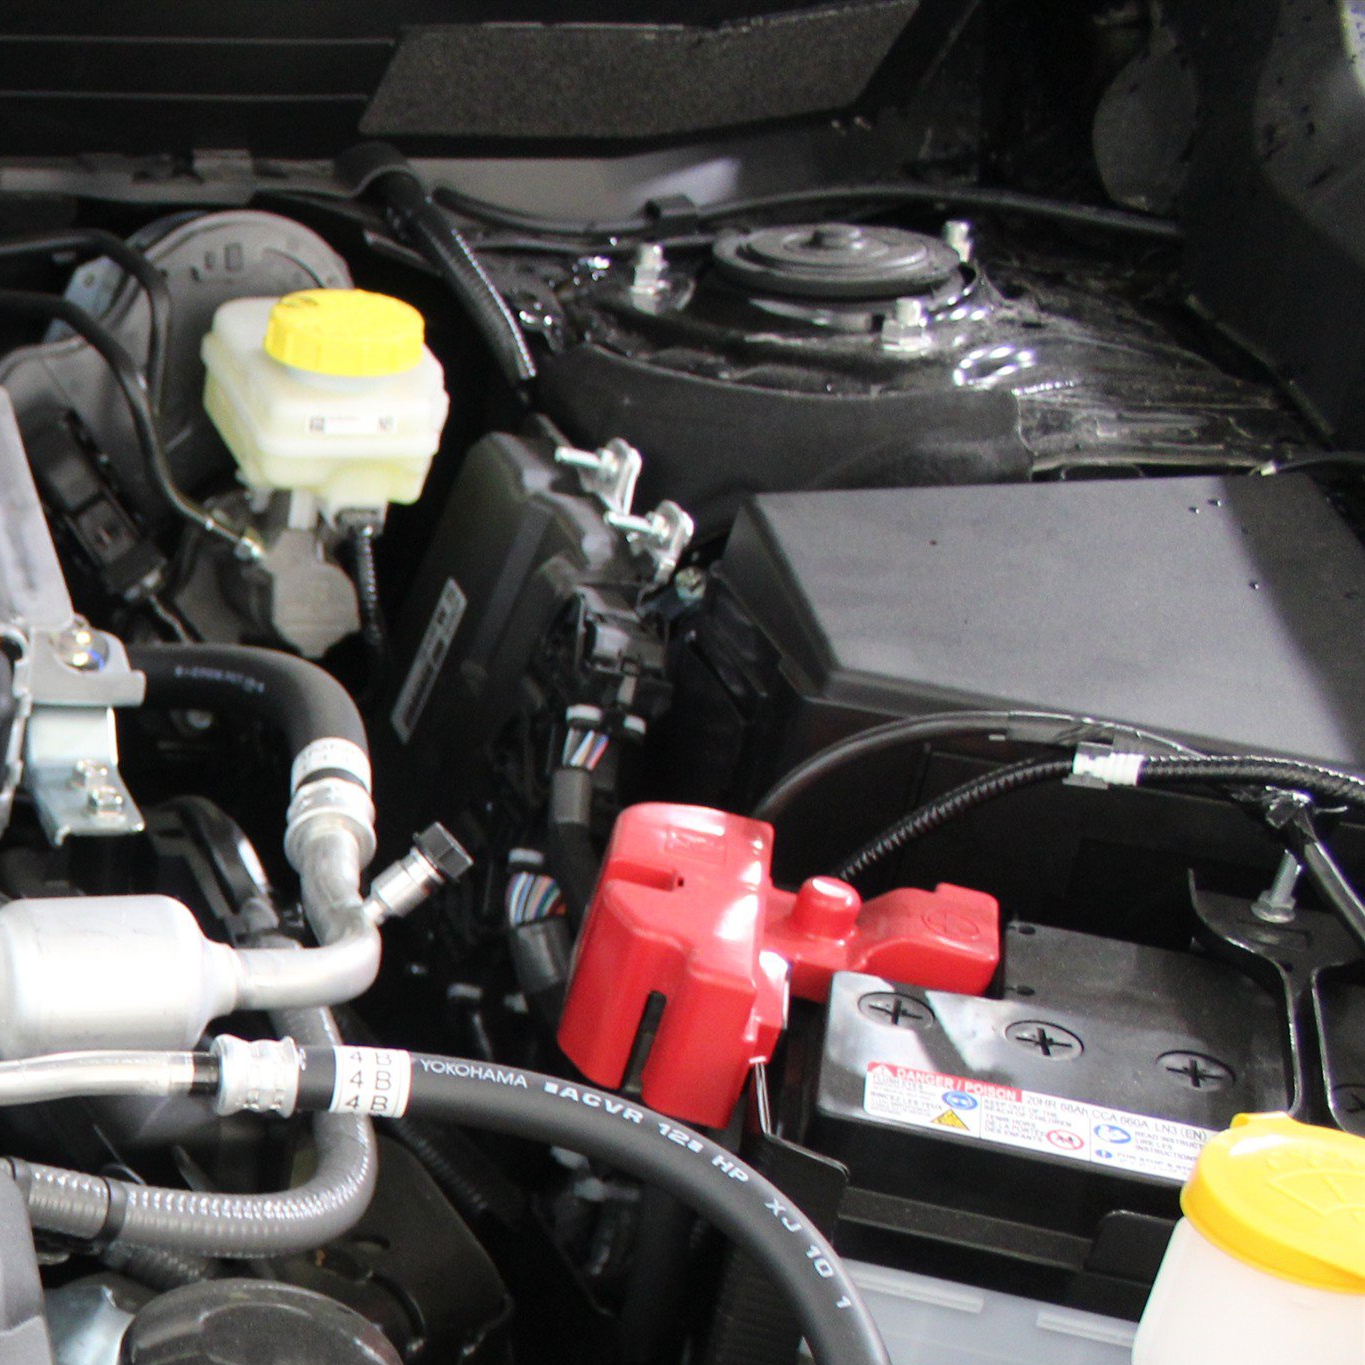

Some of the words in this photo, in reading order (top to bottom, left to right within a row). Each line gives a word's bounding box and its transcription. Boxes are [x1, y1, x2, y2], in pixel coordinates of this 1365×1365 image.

[349, 1070, 363, 1088] 4
[375, 1071, 392, 1091] B
[896, 1068, 955, 1090] DANGER
[964, 1083, 1017, 1102] POISON
[345, 1094, 359, 1110] 4
[371, 1096, 388, 1112] B
[1092, 1109, 1118, 1123] CCA
[1154, 1122, 1177, 1134] LN3
[1180, 1126, 1208, 1141] (EN)
[420, 1058, 528, 1089] YOKOHAMA
[558, 1087, 644, 1124] ACVR
[712, 1155, 750, 1182] HP
[764, 1198, 803, 1233] XJ
[804, 1245, 835, 1278] 10
